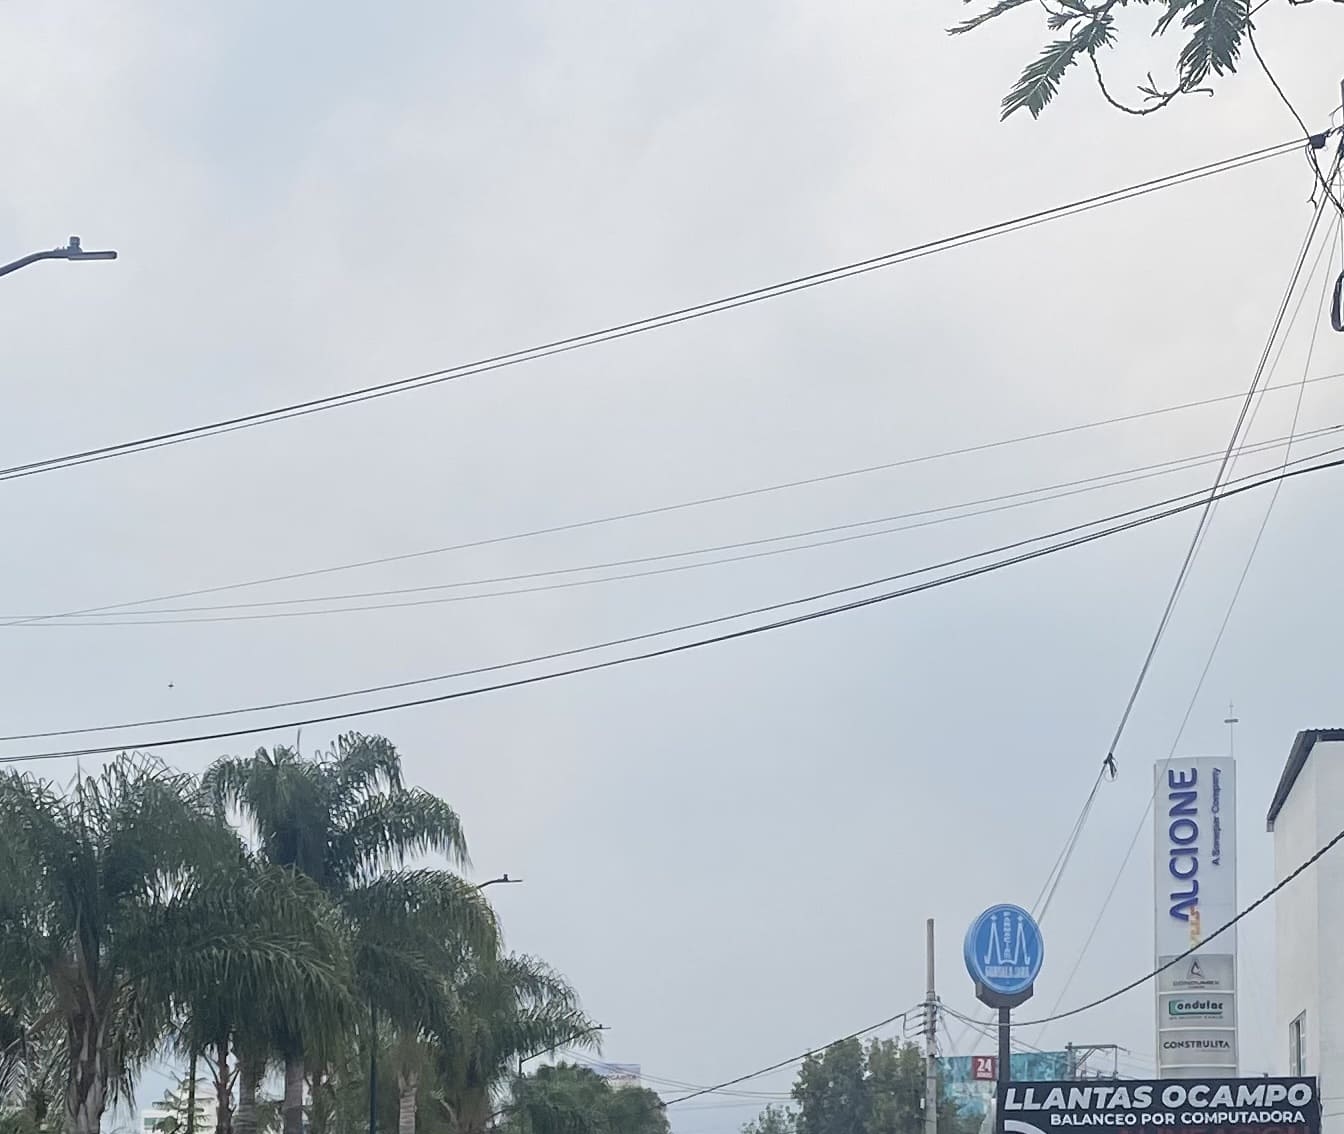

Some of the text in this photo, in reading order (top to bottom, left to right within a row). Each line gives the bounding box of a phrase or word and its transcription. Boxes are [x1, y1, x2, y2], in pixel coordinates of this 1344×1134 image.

[1168, 767, 1199, 922] ALCIONE
[1163, 1040, 1230, 1049] CONSTRULITA
[977, 1058, 992, 1072] 24
[1005, 1083, 1312, 1110] LLANTAS OCAMPO
[1050, 1111, 1305, 1126] BALANCEO POR COMPUTADORA
